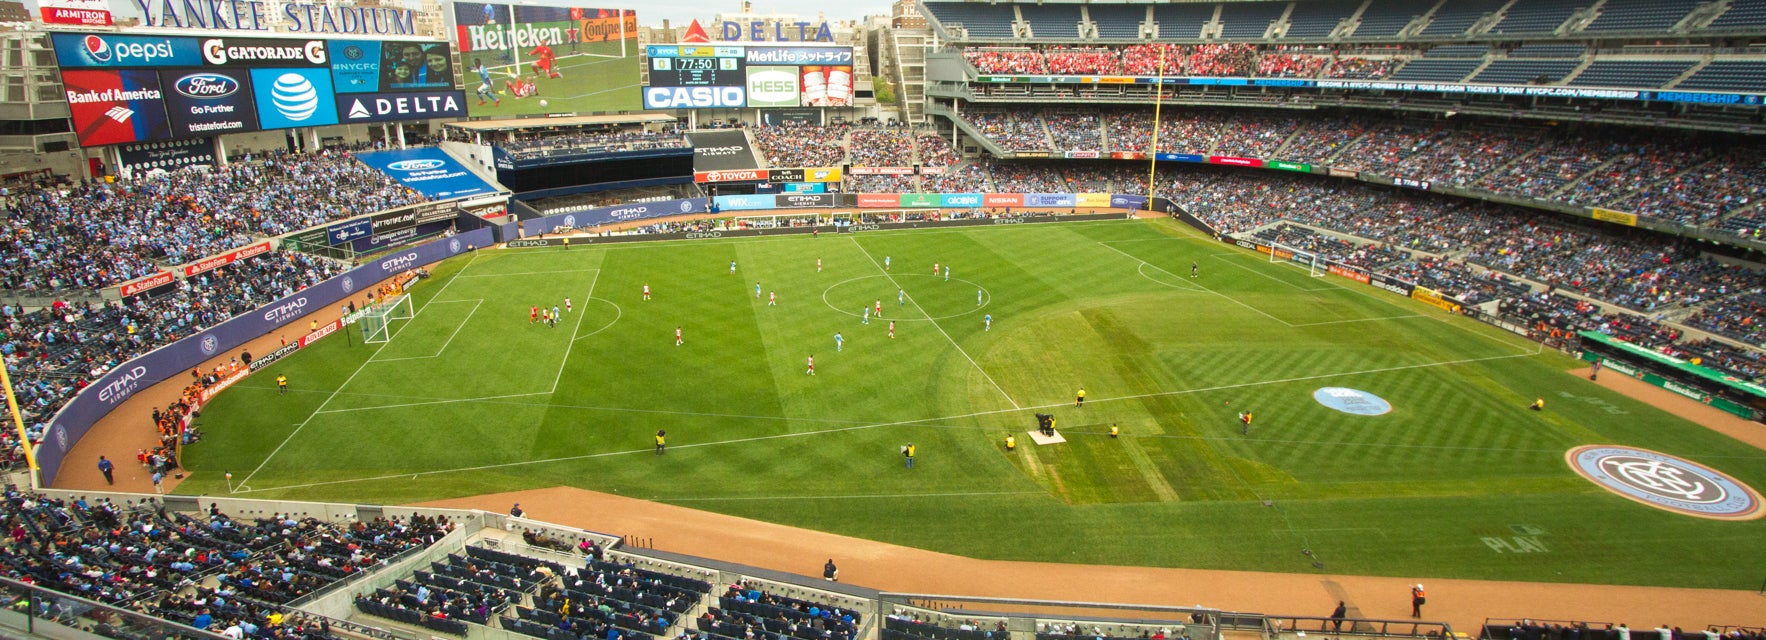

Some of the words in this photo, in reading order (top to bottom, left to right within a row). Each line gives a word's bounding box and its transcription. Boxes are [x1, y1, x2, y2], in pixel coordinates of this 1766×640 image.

[55, 10, 105, 19] ARMITRON
[135, 0, 269, 30] YANKEE
[286, 3, 416, 35] STADIUM
[468, 22, 563, 50] Heineken
[584, 16, 637, 41] Continetal
[723, 21, 834, 42] DELTA
[116, 40, 174, 62] pepsi
[228, 46, 304, 60] GATORADE
[747, 50, 797, 62] MetLife
[798, 52, 852, 61] メットライフ
[658, 60, 665, 69] 0
[681, 60, 712, 69] 77:50
[725, 60, 732, 69] 5
[188, 77, 227, 95] Ford
[752, 80, 795, 93] HESS
[1437, 84, 1465, 92] SEASON
[1498, 86, 1524, 94] TODAY
[1526, 88, 1639, 99] NYCFC.COM/MEMBERSHIP
[67, 88, 100, 104] Bank
[100, 87, 114, 102] of
[114, 87, 161, 101] America
[648, 87, 744, 108] CASIO
[1657, 91, 1740, 103] MEMBERSHIP
[191, 105, 204, 115] Go
[205, 104, 234, 113] Further
[376, 96, 459, 115] DELTA
[189, 120, 243, 132] tristateford.com
[401, 161, 434, 170] Ford
[722, 171, 758, 181] TOYOTA
[611, 206, 647, 218] ETIHAD
[686, 231, 722, 239] ETIHAD
[848, 224, 879, 232] ETIHAD
[382, 253, 417, 270] ETIHAD
[389, 261, 412, 273] AIRWAYS
[264, 297, 307, 321] ETIHAD
[275, 308, 302, 324] AIRWAYS
[305, 323, 337, 343] ADVOCARE
[275, 341, 298, 357] ETIHAD
[250, 353, 275, 369] ETIHAD
[1602, 358, 1636, 376] Heineken
[99, 366, 147, 402] ETIHAD
[1664, 380, 1701, 400] Heineken
[109, 381, 138, 405] AIRWAYS
[1480, 537, 1549, 554] PLAY
